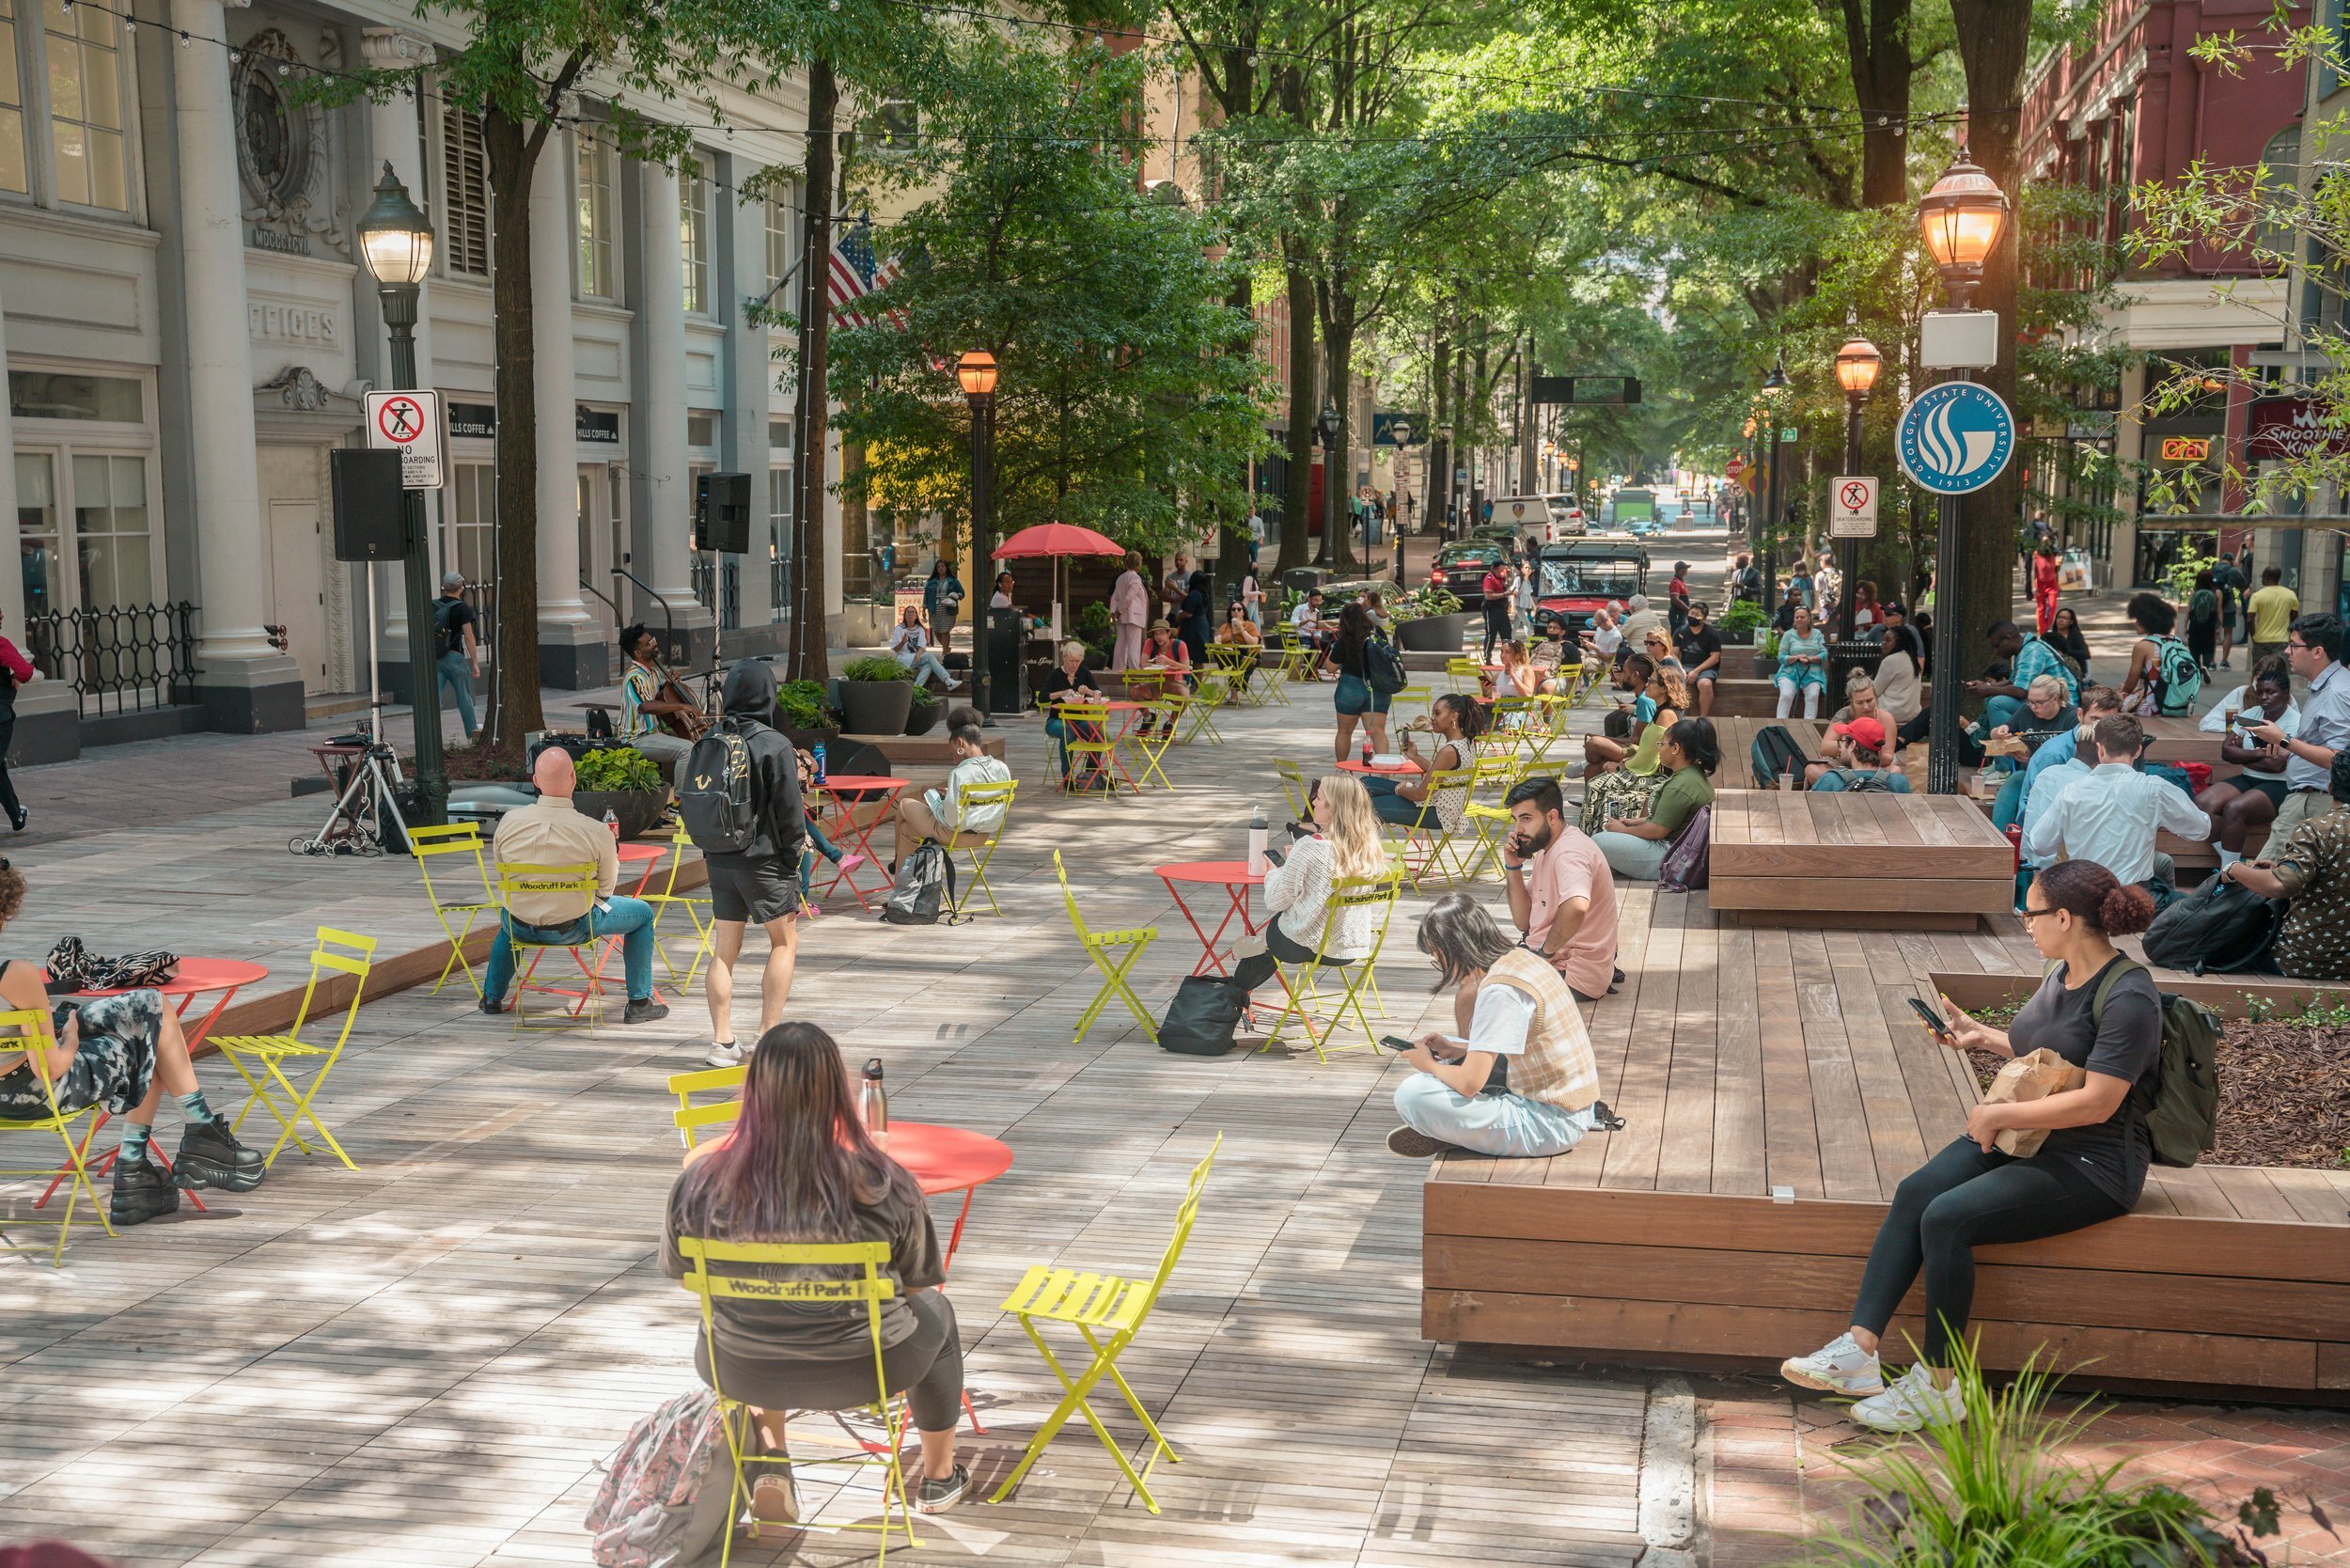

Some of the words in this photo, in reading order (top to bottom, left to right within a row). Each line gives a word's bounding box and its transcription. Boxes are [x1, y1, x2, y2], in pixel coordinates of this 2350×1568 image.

[248, 304, 334, 341] FFICES
[462, 423, 486, 434] COFFEE
[1905, 413, 1924, 472] GEORGIA
[1924, 388, 1967, 407] STATE
[1976, 393, 2007, 470] UNIVERSITY
[591, 429, 610, 440] COFFEE
[397, 445, 413, 455] NO
[2286, 440, 2320, 455] KiN
[401, 456, 435, 464] OARDING
[1726, 465, 1743, 475] STOP
[1938, 478, 1970, 488] 1913
[519, 881, 559, 890] Woodruff
[560, 881, 579, 889] Park
[1374, 892, 1388, 901] Park
[0, 1040, 19, 1049] ark
[729, 1279, 810, 1296] Woodruff
[814, 1283, 852, 1296] Park
